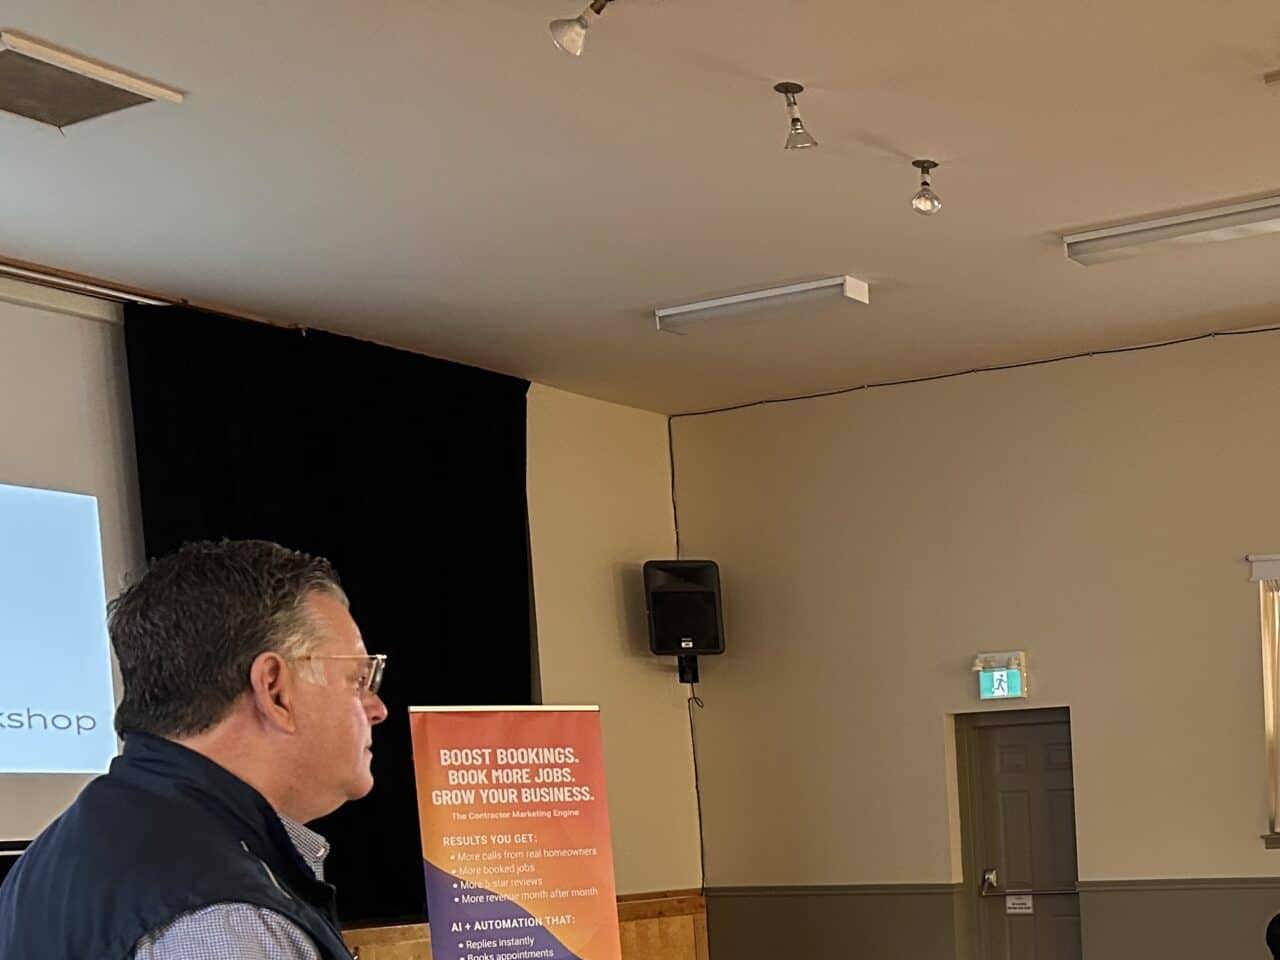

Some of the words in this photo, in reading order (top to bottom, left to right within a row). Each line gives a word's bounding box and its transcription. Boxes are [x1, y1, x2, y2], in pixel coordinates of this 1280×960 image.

[440, 749, 492, 765] BOOST
[496, 747, 580, 764] BOOKINGS.
[448, 769, 488, 785] BOOK
[491, 768, 531, 783] MORE
[534, 767, 576, 783] JOBS.
[431, 789, 475, 805] GROW
[480, 788, 518, 803] YOUR
[521, 786, 595, 802] BUSINESS.
[452, 812, 467, 820] The
[468, 811, 510, 820] Contractor
[511, 810, 552, 819] Marketing
[553, 809, 580, 818] Engine
[443, 835, 488, 847] RESULTS
[490, 834, 512, 844] YOU
[514, 833, 538, 844] GET:
[457, 852, 481, 861] More
[481, 850, 502, 860] calls
[503, 849, 525, 858] from
[526, 848, 542, 858] real
[543, 847, 597, 857] homeowners
[459, 866, 481, 875] More
[483, 864, 515, 874] booked
[516, 863, 535, 874] jobs
[460, 880, 482, 889] More
[512, 878, 543, 887] reviews
[461, 895, 485, 903] More
[521, 889, 550, 899] month
[551, 888, 570, 898] after
[571, 886, 598, 896] month
[451, 922, 463, 932] AI
[474, 918, 543, 930] AUTOMATION
[545, 915, 576, 925] THAT:
[466, 940, 497, 951] Replies
[499, 936, 535, 947] instantly
[496, 949, 554, 960] appointments
